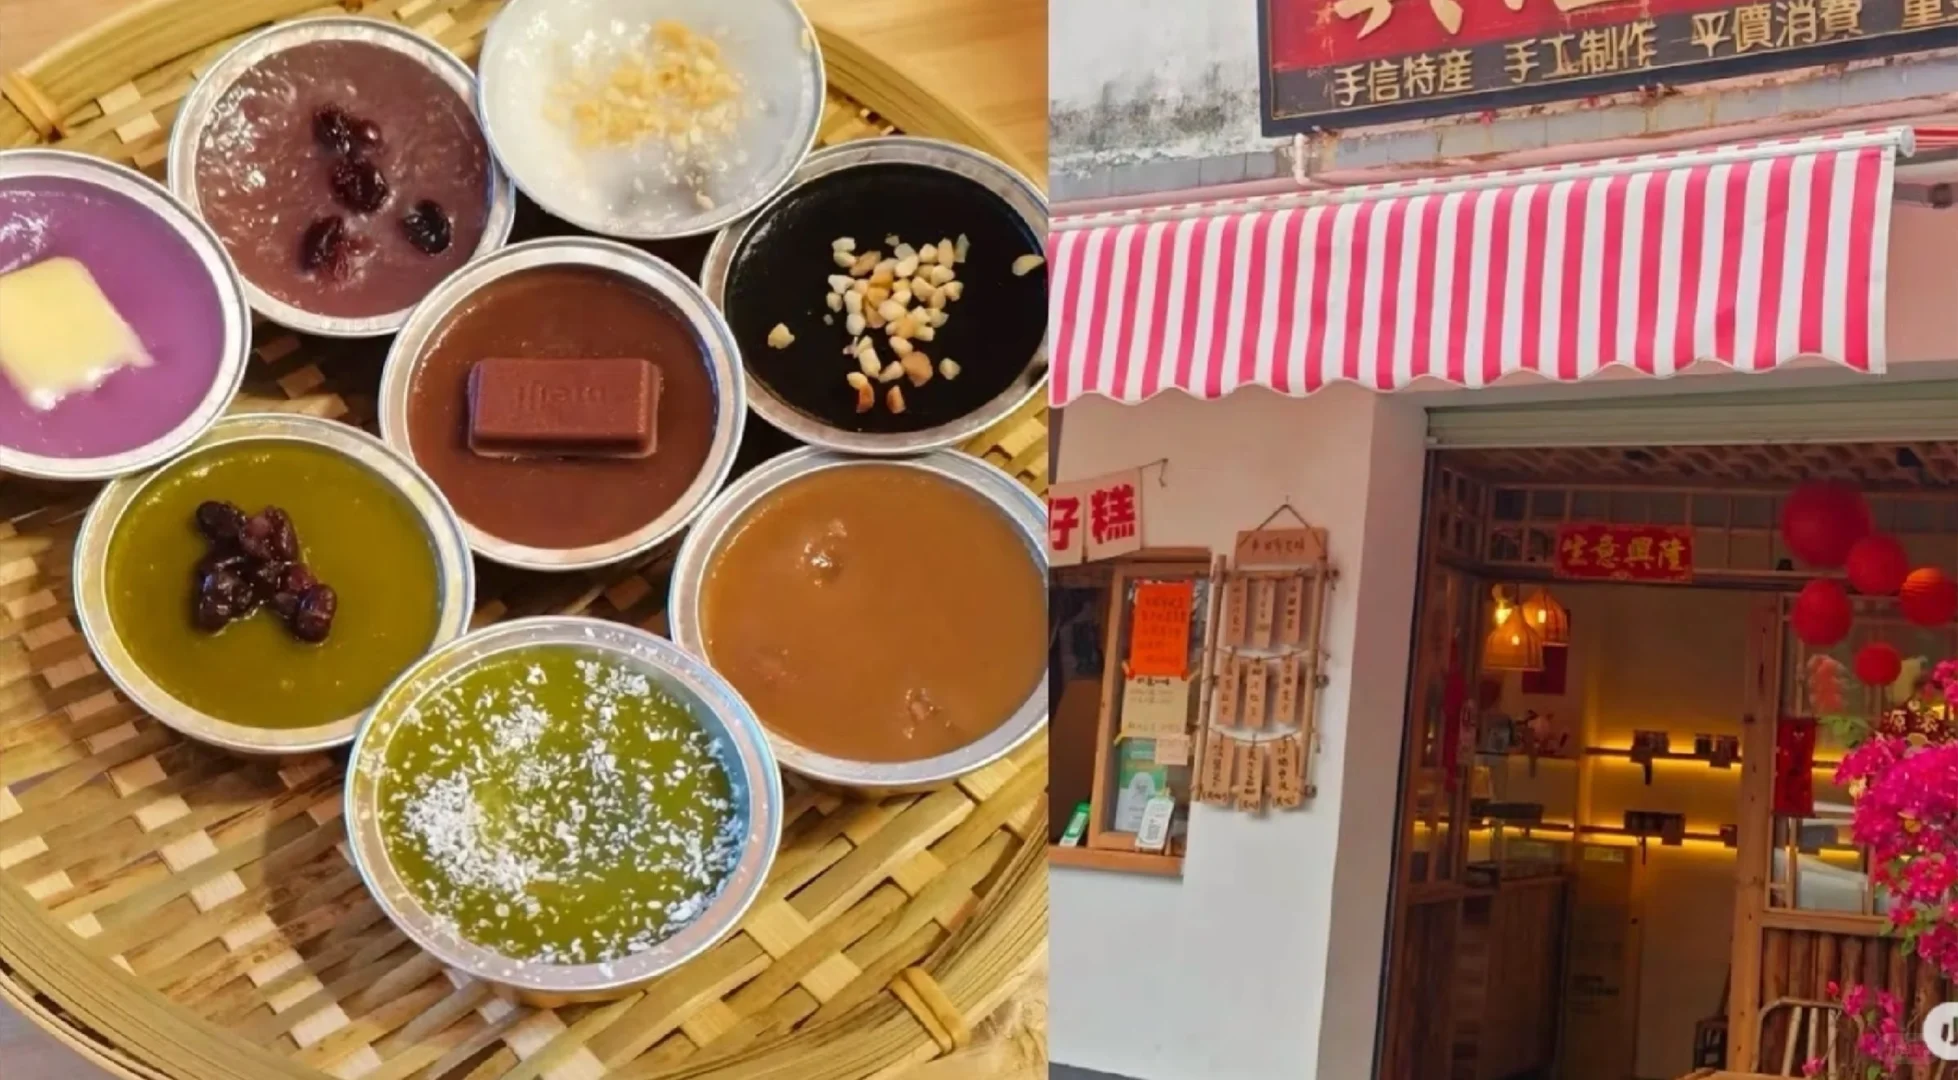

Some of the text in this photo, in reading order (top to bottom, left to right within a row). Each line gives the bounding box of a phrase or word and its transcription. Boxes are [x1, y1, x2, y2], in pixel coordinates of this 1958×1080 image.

[1334, 48, 1473, 106] 手信特產
[1504, 22, 1658, 83] 手工制作
[1691, 0, 1863, 56] 平價消費
[1562, 532, 1686, 571] 生意興隆
